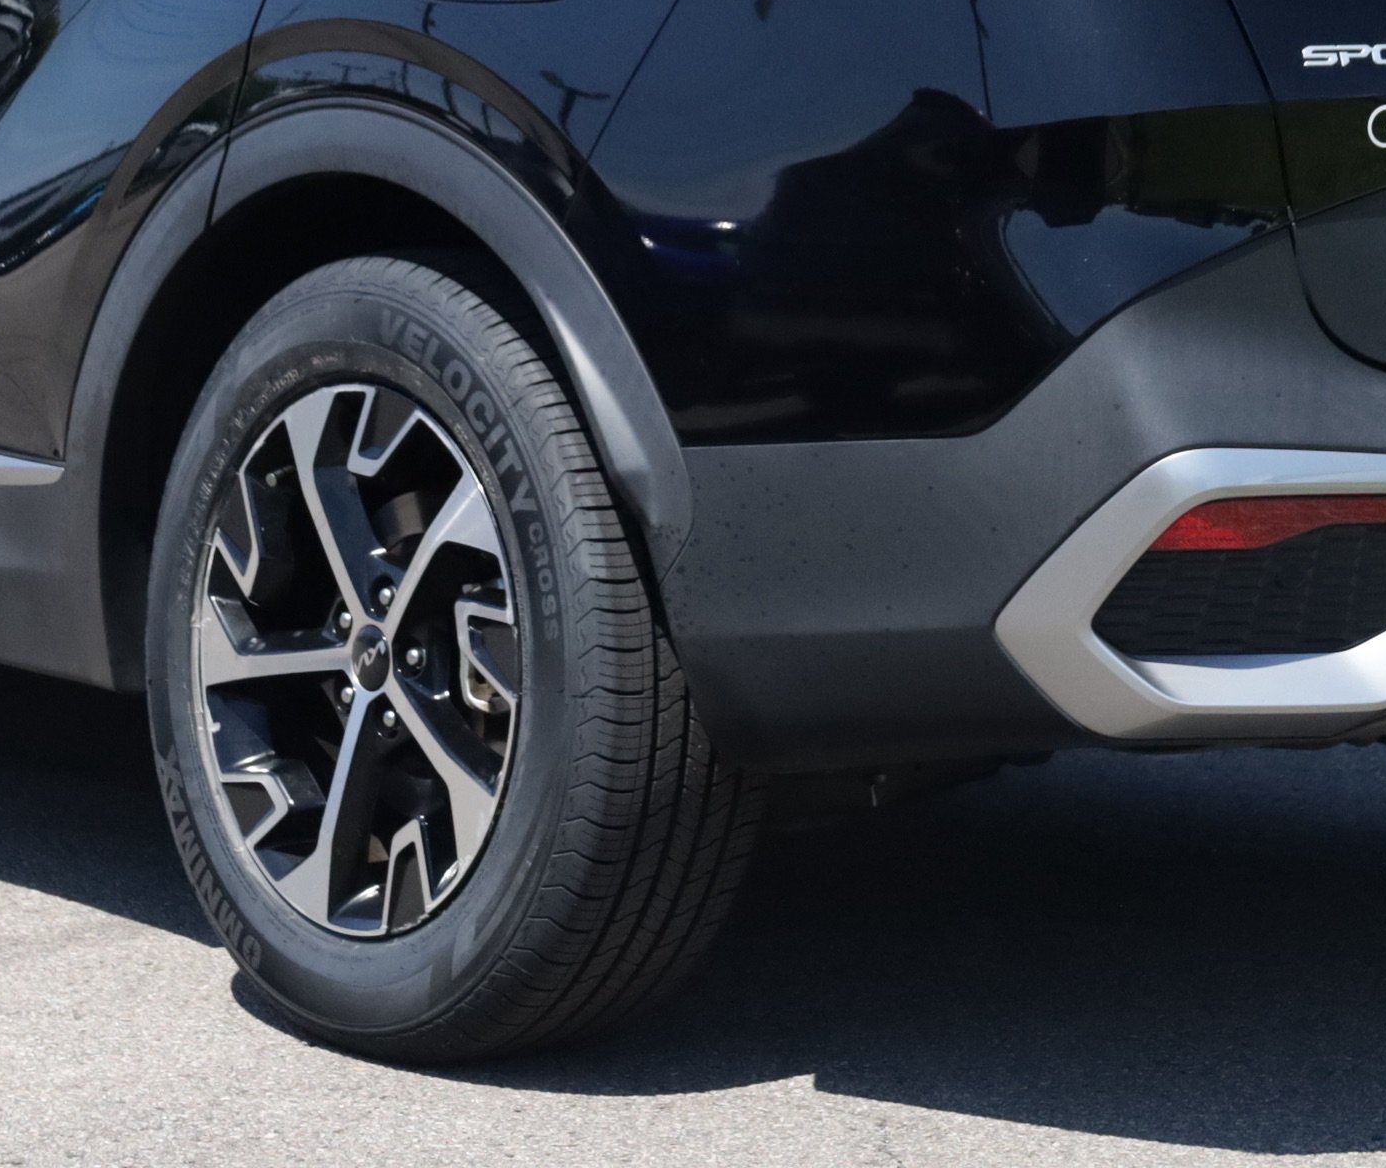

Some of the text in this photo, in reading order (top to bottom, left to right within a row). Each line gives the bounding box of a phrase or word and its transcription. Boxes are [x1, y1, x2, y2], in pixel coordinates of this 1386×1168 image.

[378, 308, 539, 515] VELOCITY
[527, 521, 559, 641] CROSS
[155, 743, 262, 970] OMNIMAX
